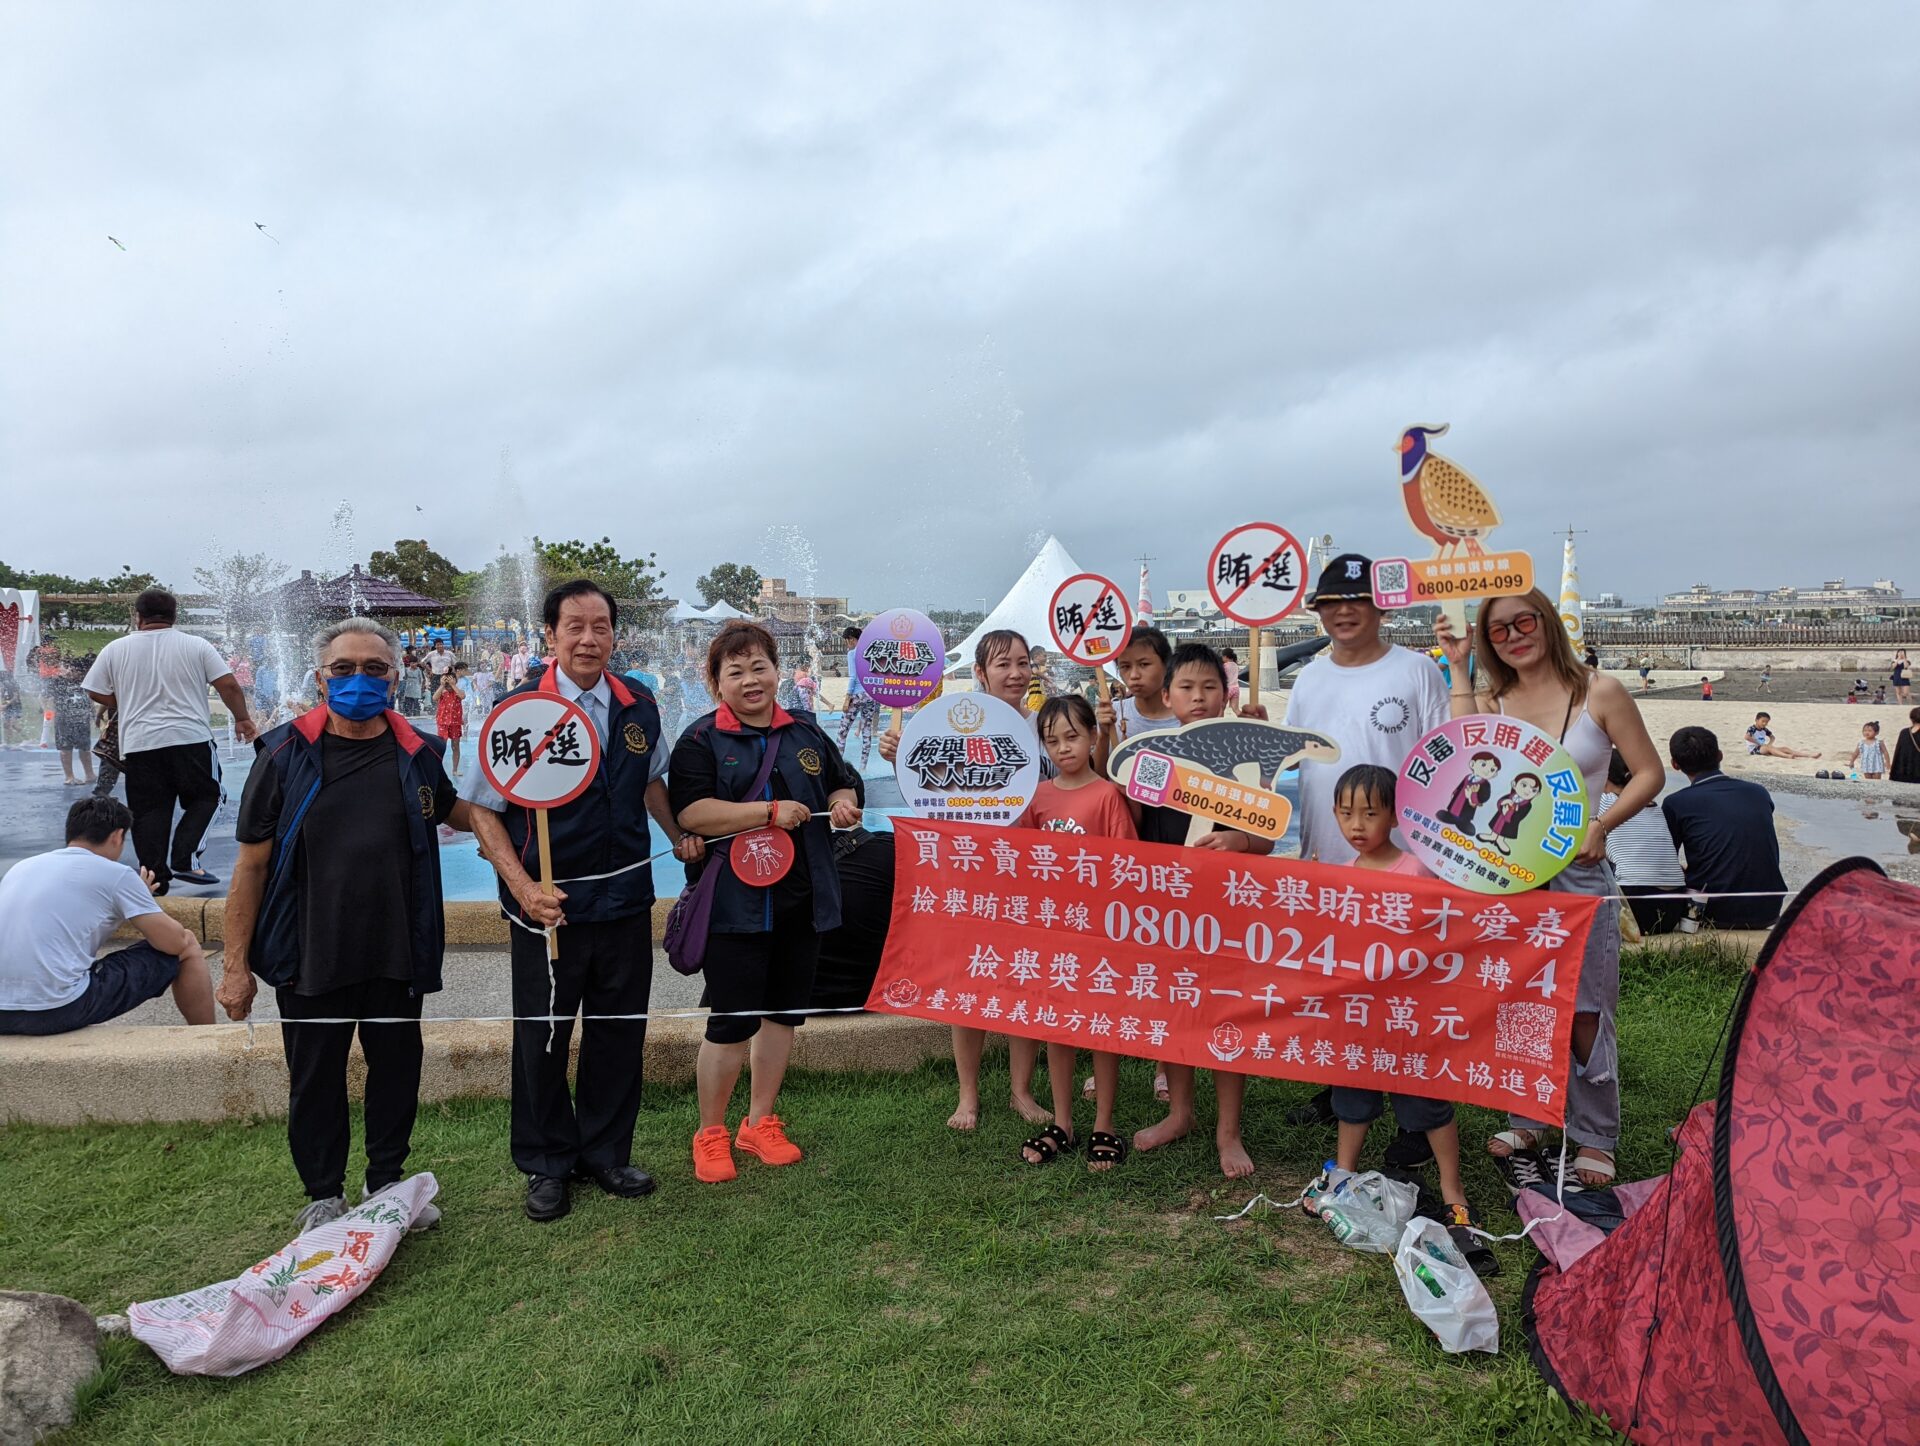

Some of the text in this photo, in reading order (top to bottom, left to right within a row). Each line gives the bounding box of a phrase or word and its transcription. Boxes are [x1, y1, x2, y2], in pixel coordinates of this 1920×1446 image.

[1216, 551, 1298, 591] 賄選
[1417, 574, 1523, 596] 0800-024-099
[1426, 559, 1510, 576] 檢舉賄選專線
[1056, 594, 1125, 636] 賄選
[863, 640, 936, 661] 檢舉賄選
[491, 721, 591, 770] 賄選
[906, 735, 1031, 766] 檢舉賄選
[918, 765, 1016, 788] 人人有責
[1186, 775, 1270, 811] 檢舉賄選專線
[1408, 721, 1583, 860] 反毒 反賄選 反暴力
[914, 796, 1025, 808] 檢舉電話 0800-024-099
[1172, 788, 1277, 831] 0800-024-099
[1410, 828, 1511, 889] 臺灣嘉義地方檢察署
[1440, 826, 1536, 883] 0800-024-099
[911, 830, 1571, 951] 買票賣票有夠瞎 檢舉賄選才愛嘉
[911, 885, 1557, 999] 檢舉賄選專線 0800-024-099 轉 4
[966, 943, 1470, 1041] 檢舉獎金最高一千五百萬元
[926, 987, 1170, 1047] 臺灣嘉義地方檢察署
[1251, 1032, 1558, 1106] 嘉義榮譽觀護人協進會
